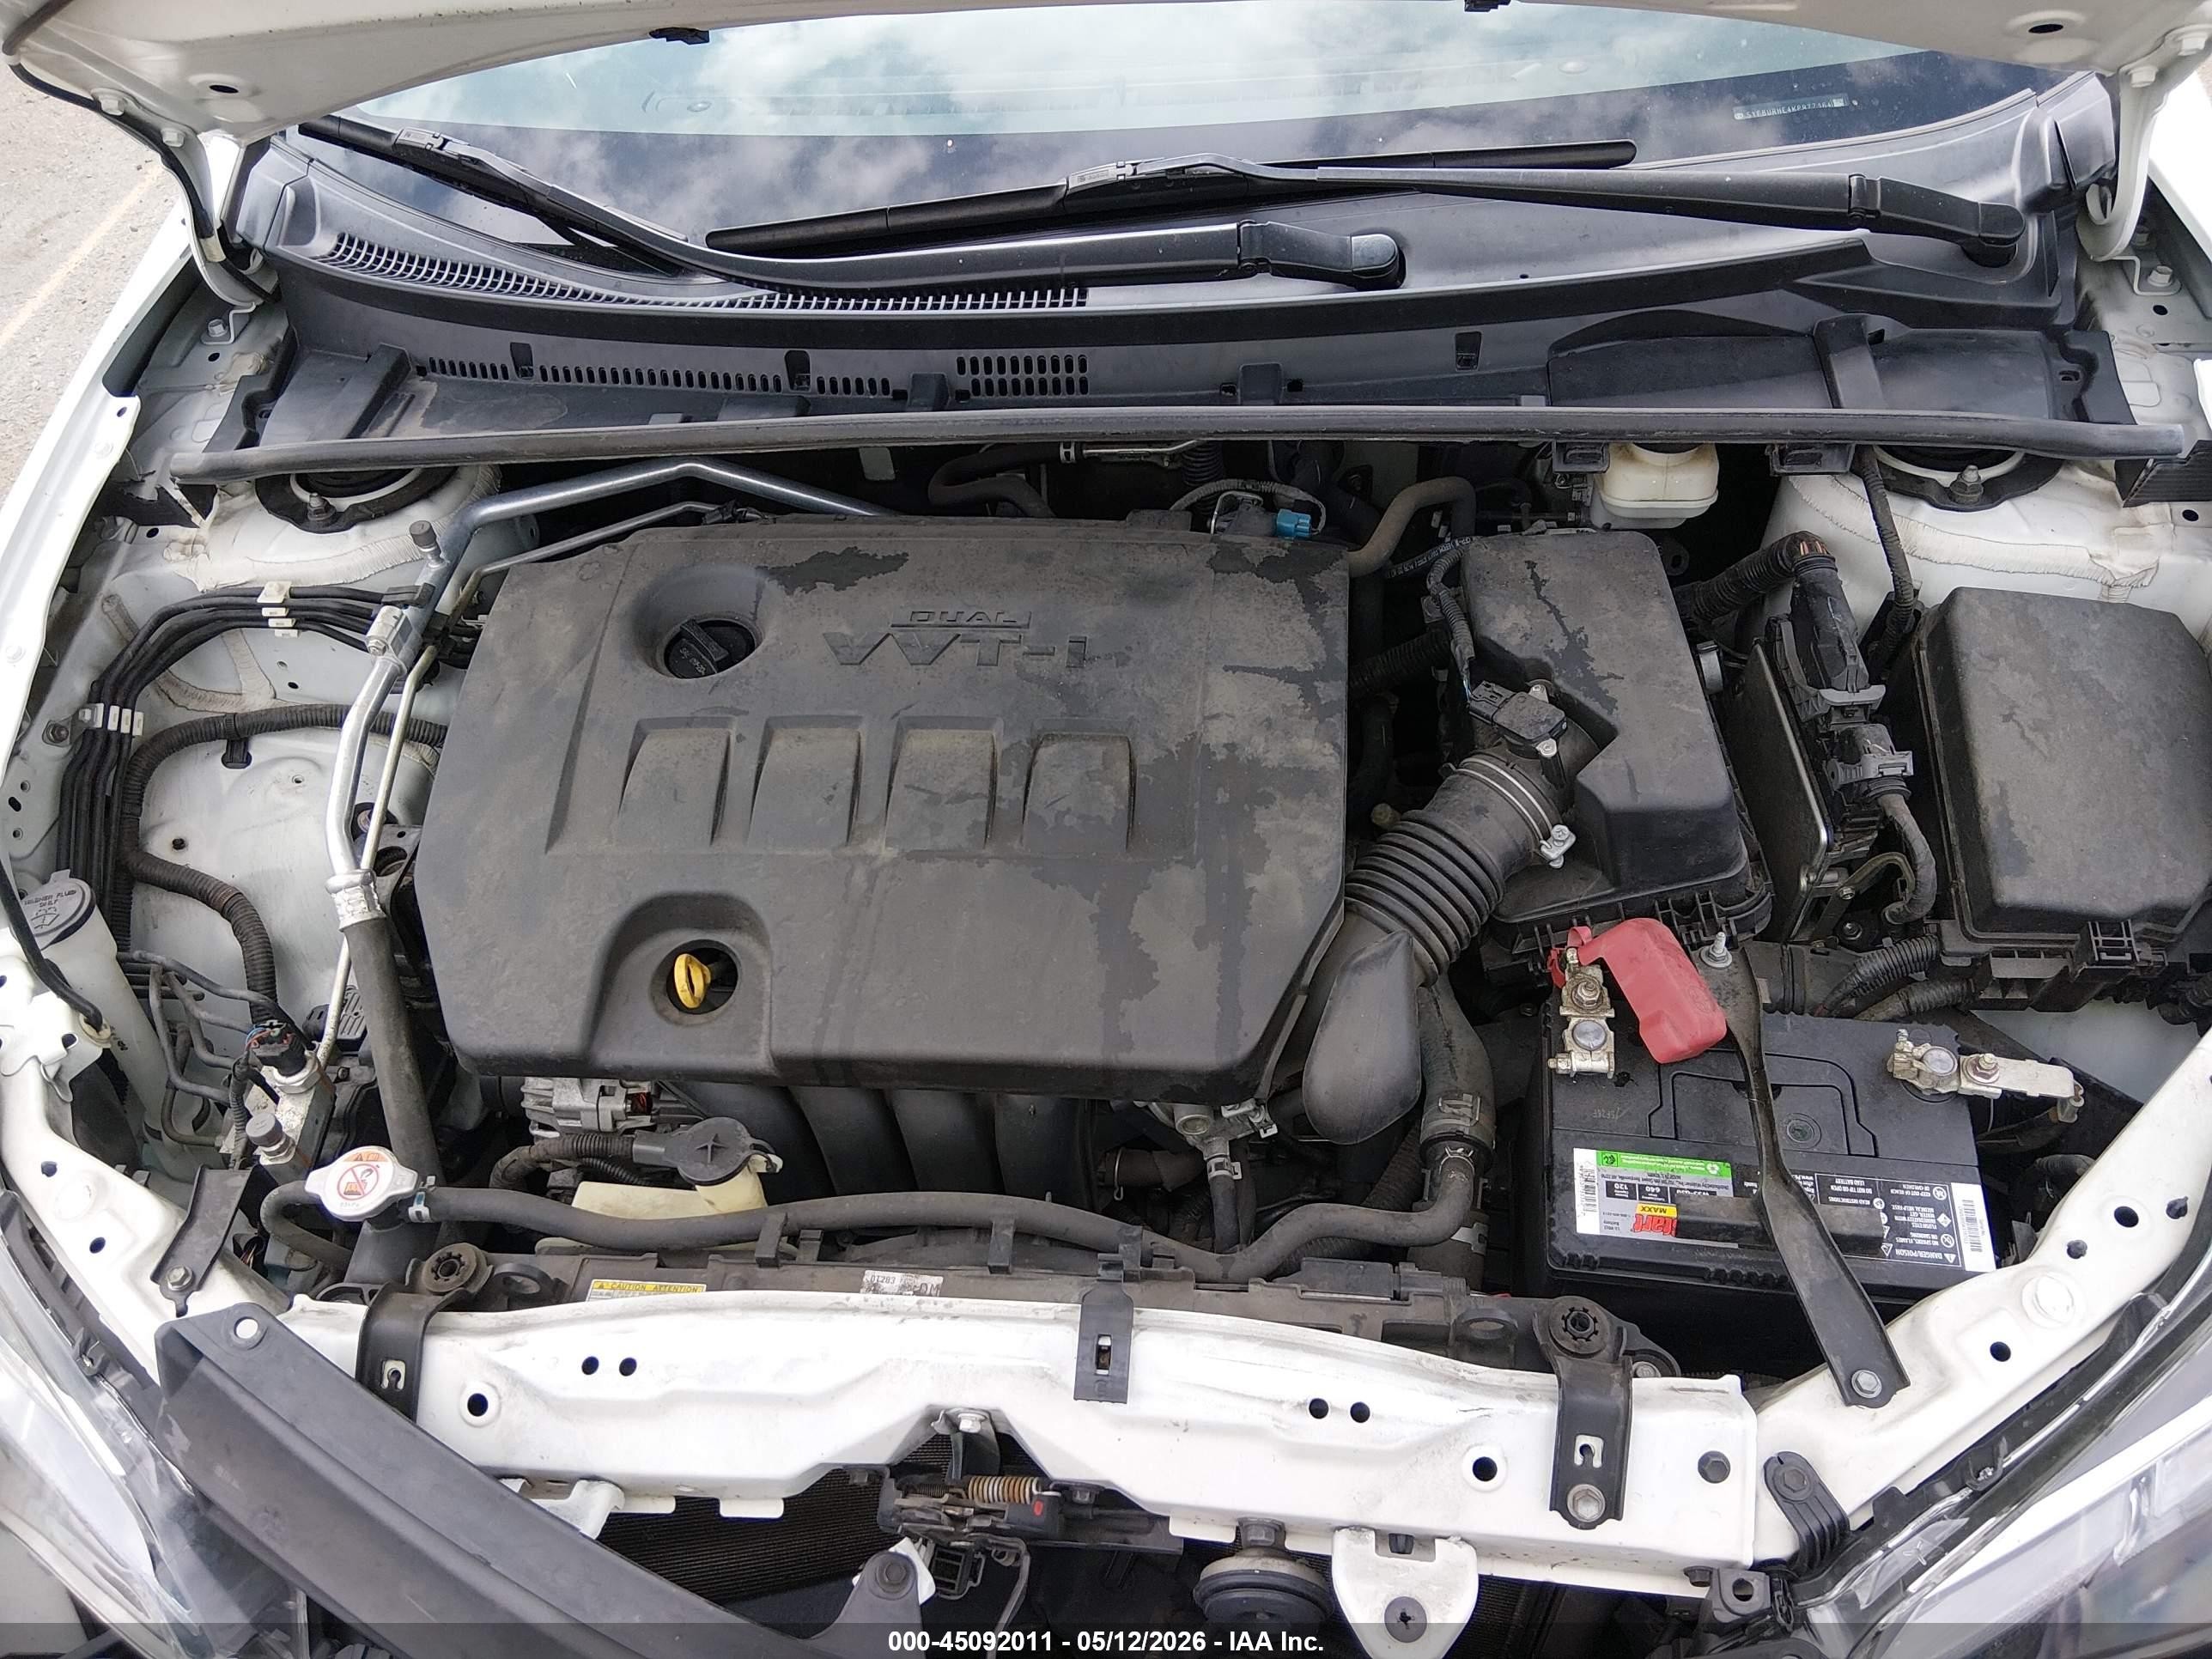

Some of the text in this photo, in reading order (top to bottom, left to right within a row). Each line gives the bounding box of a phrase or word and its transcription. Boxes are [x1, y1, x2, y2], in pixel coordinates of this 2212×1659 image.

[910, 611, 1018, 623] DUAL
[1640, 1205, 1668, 1215] MAXX
[1895, 1249, 1943, 1260] DANGER/POISON
[611, 1281, 698, 1293] CAUTION ATTENTION
